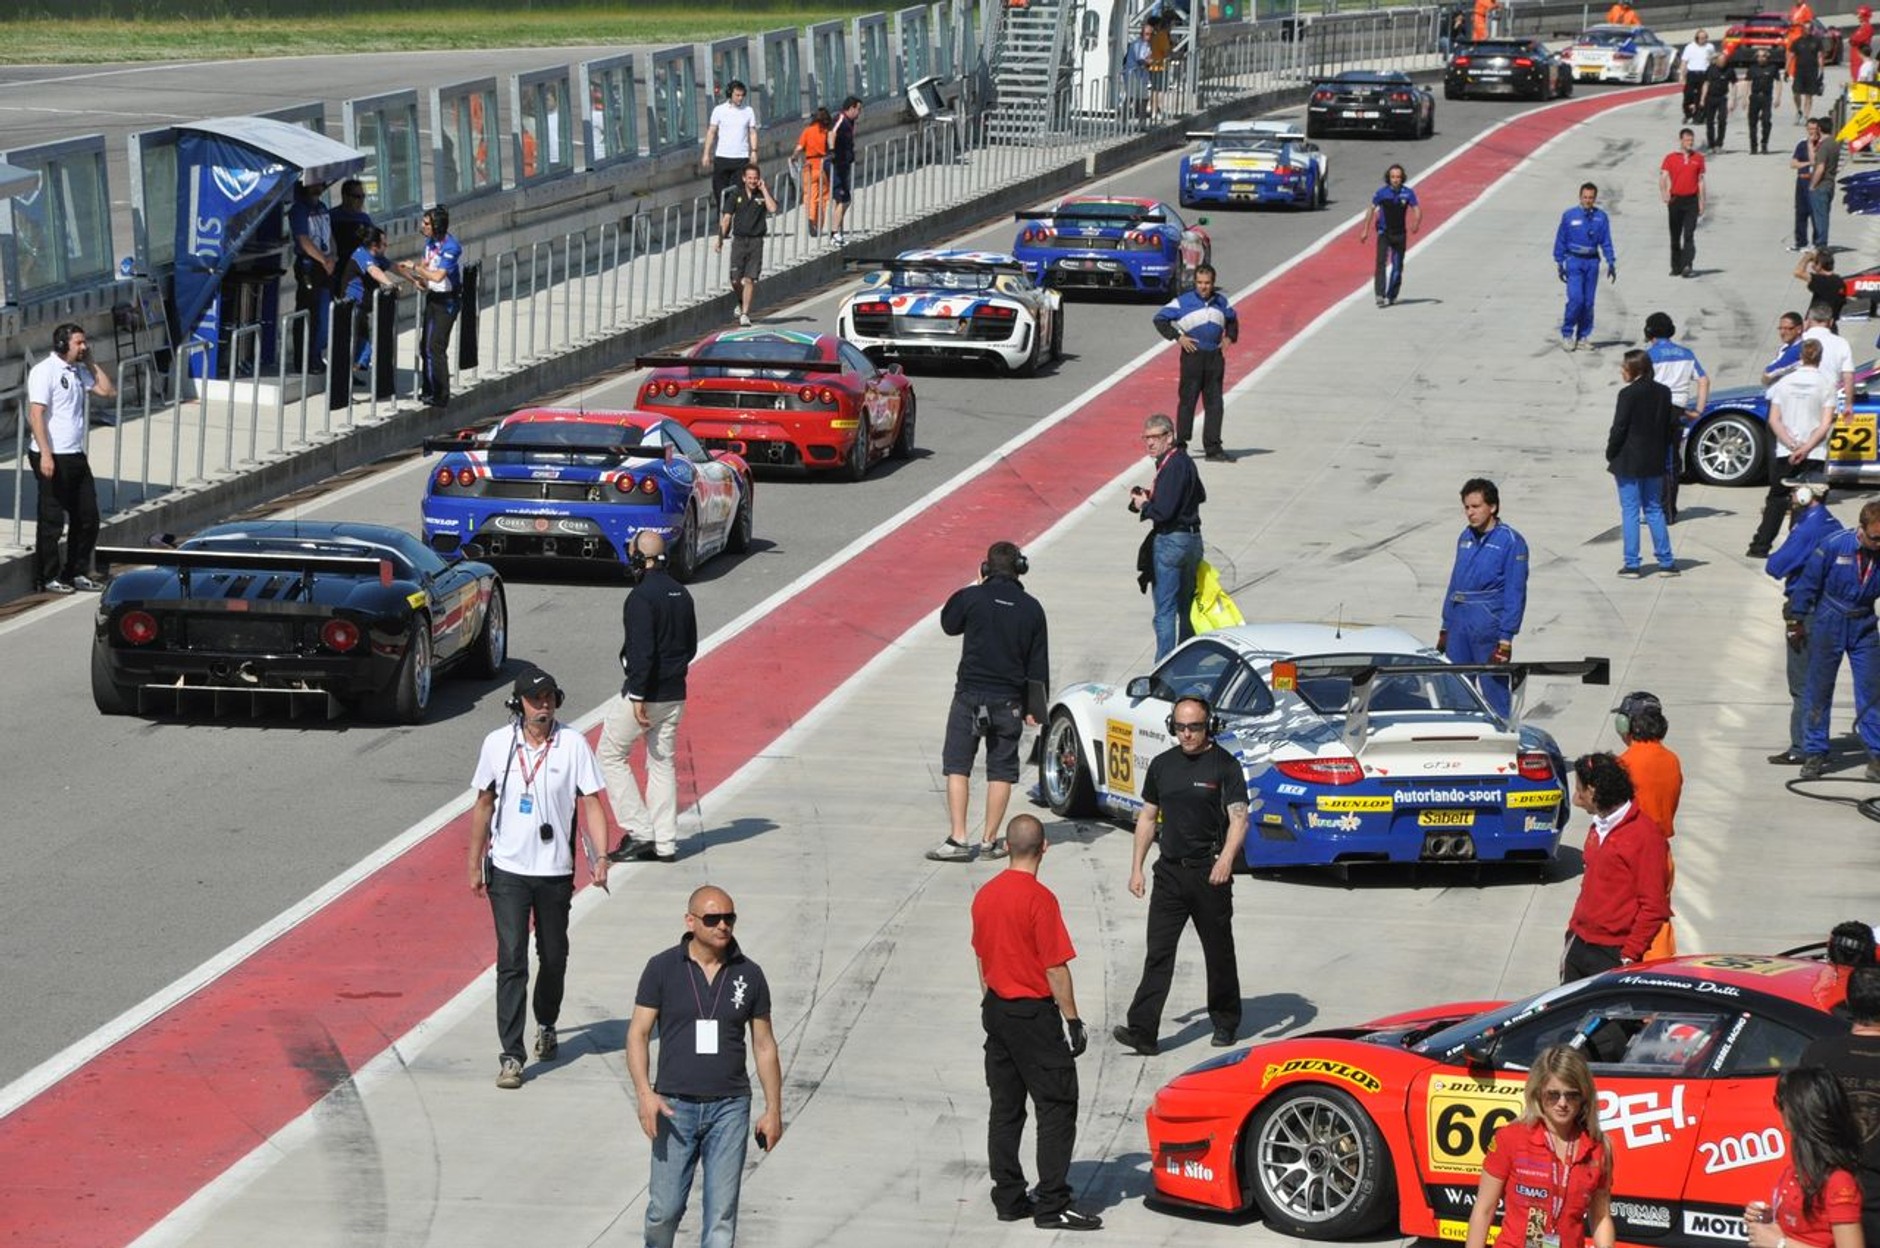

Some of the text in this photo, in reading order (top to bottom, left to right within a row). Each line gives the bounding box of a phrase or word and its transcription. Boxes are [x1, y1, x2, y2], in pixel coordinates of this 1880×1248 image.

[1829, 427, 1872, 451] 52
[1108, 742, 1131, 782] 65
[1331, 800, 1390, 808] DUNLOP
[1394, 788, 1502, 803] Autorlando-sport
[1619, 976, 1740, 997] Massimo Dutti
[1727, 1017, 1747, 1044] RACING
[1280, 1059, 1381, 1092] DUNLOP
[1448, 1082, 1524, 1095] DUNLOP
[1697, 1126, 1786, 1175] 2000
[1184, 1159, 1214, 1181] Sito
[1515, 1184, 1549, 1199] LEMAG
